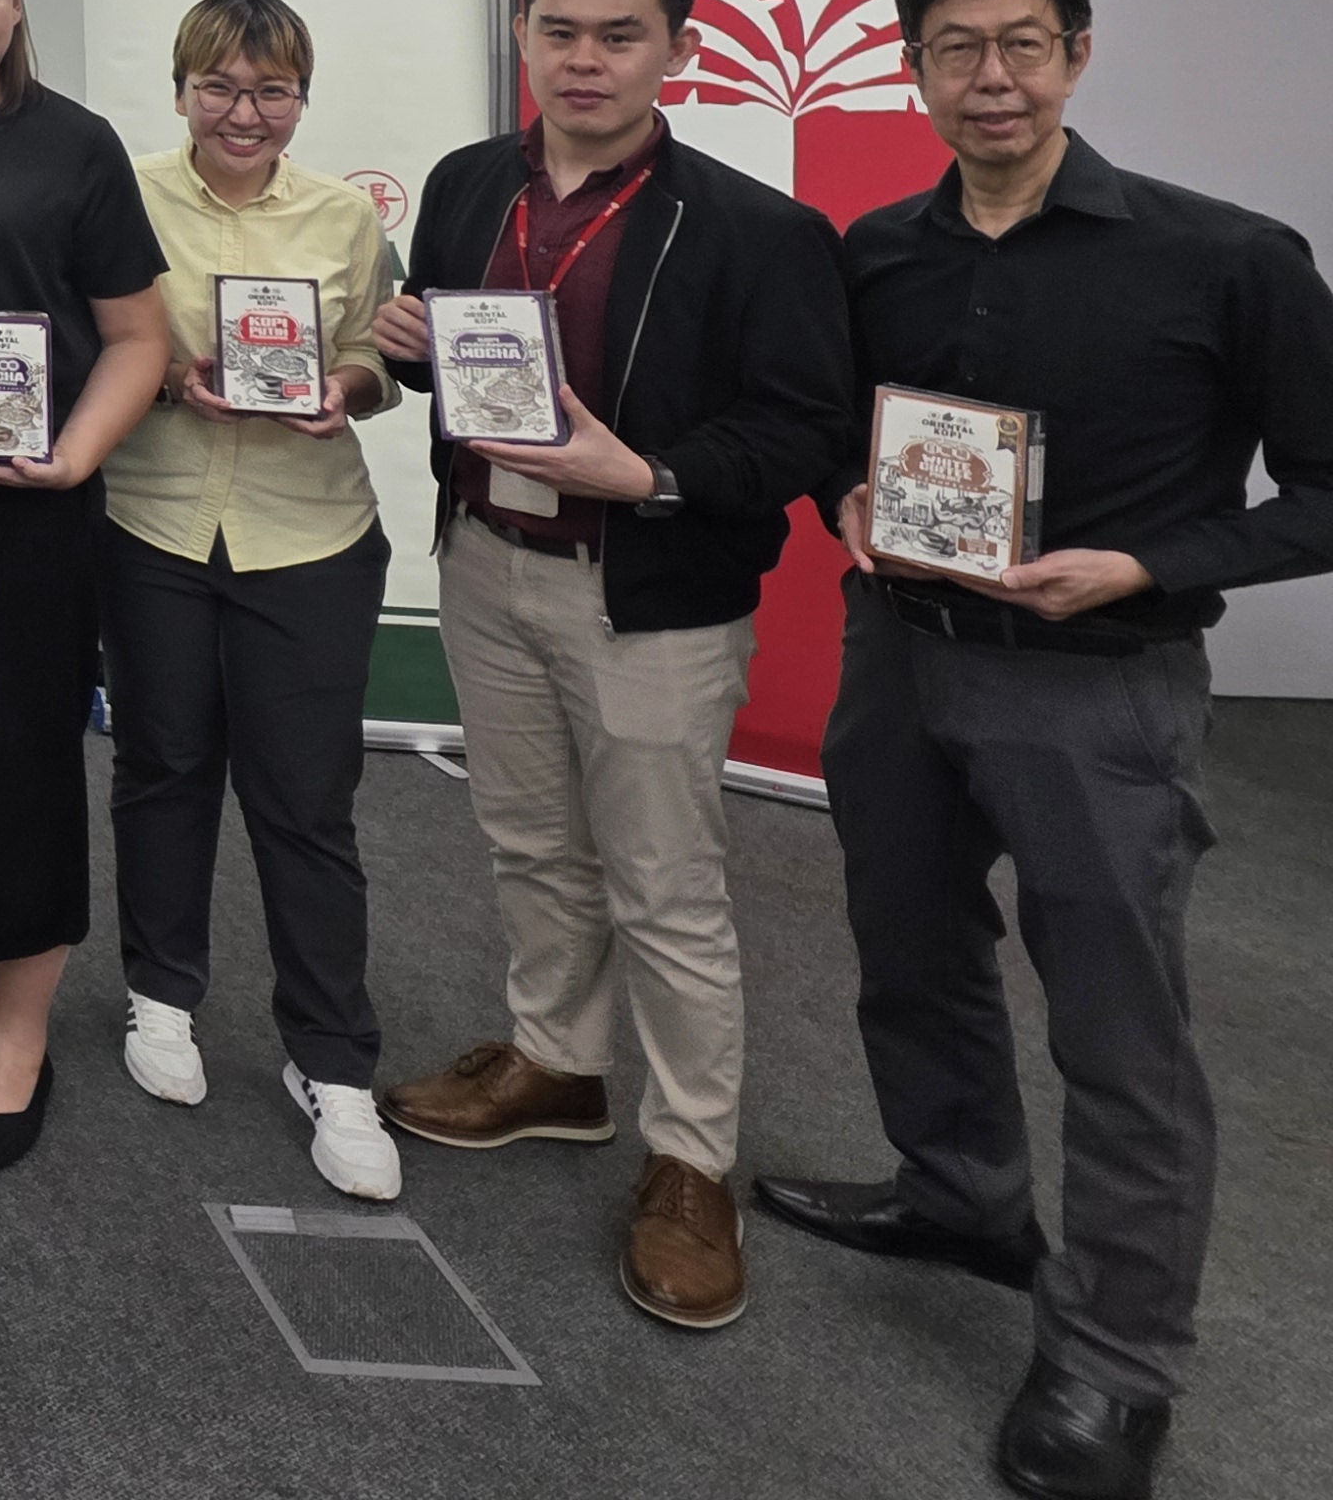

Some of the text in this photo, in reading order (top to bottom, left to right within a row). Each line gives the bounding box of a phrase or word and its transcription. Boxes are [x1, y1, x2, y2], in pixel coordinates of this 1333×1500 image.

[248, 316, 288, 328] KOPI
[460, 347, 522, 360] MOCHA
[921, 418, 976, 436] ORIENTAL
[933, 427, 962, 440] KOPI
